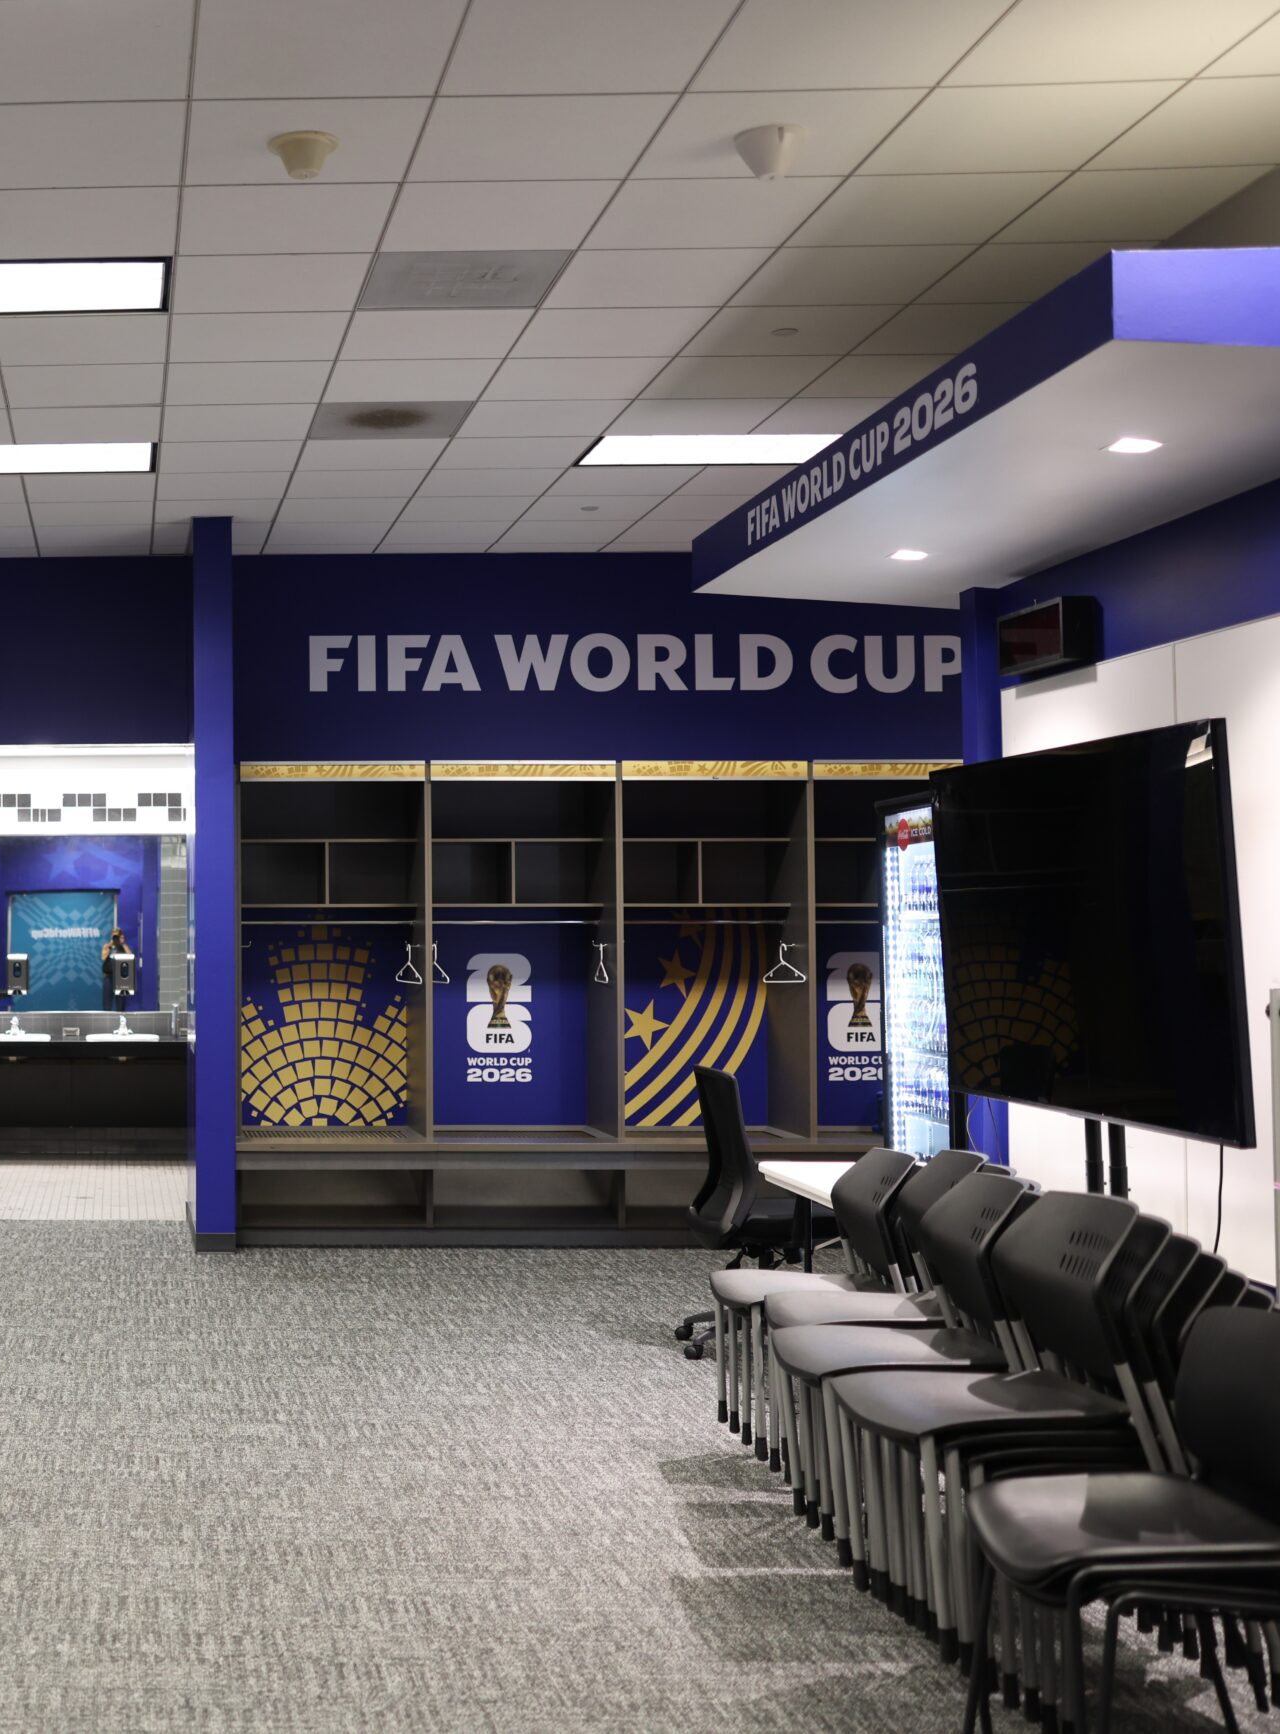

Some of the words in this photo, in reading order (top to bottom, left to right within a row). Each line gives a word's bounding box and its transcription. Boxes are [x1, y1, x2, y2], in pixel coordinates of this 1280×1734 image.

[747, 494, 780, 546] FIFA
[782, 452, 846, 523] WORLD
[849, 421, 889, 481] CUP
[893, 363, 978, 456] 2026
[309, 635, 481, 692] FIFA
[494, 633, 794, 693] WORLD
[810, 634, 962, 694] CUP
[485, 1033, 514, 1044] FIFA
[847, 1032, 876, 1042] FIFA
[467, 1057, 507, 1066] WORLD
[509, 1057, 532, 1066] CUP
[828, 1056, 869, 1065] WORLD
[466, 1068, 532, 1082] 2026
